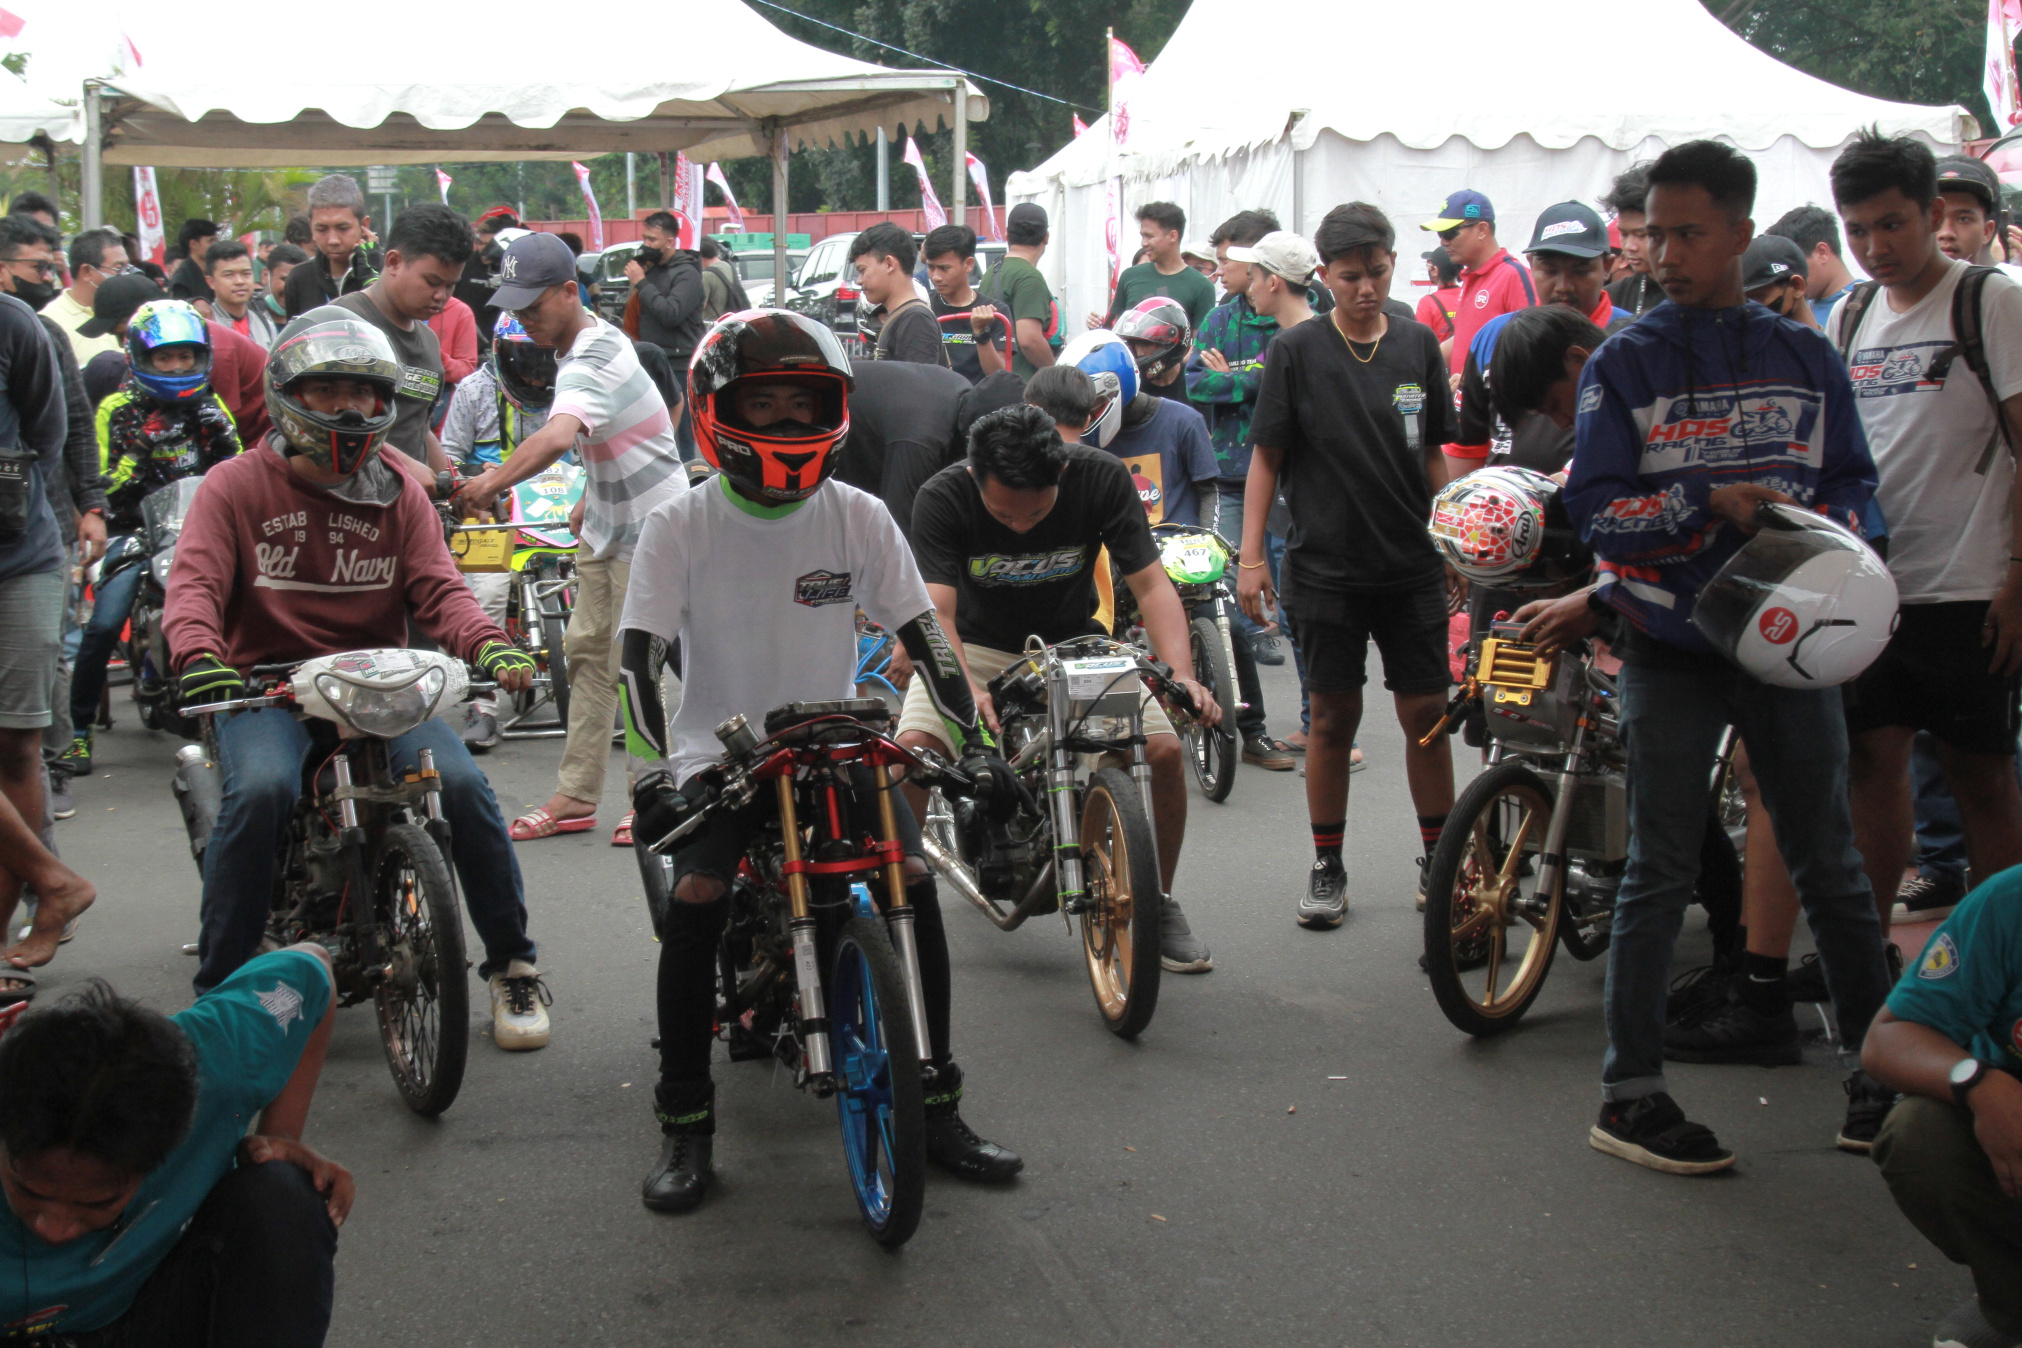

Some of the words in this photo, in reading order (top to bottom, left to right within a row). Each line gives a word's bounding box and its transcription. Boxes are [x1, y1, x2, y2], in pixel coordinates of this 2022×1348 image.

[1647, 417, 1732, 442] HDS
[716, 435, 752, 456] PRO
[294, 530, 306, 542] 19
[329, 531, 345, 544] 94
[1512, 516, 1531, 559] Arai
[1184, 548, 1206, 557] 467
[255, 542, 299, 578] Old
[330, 548, 397, 588] Navy
